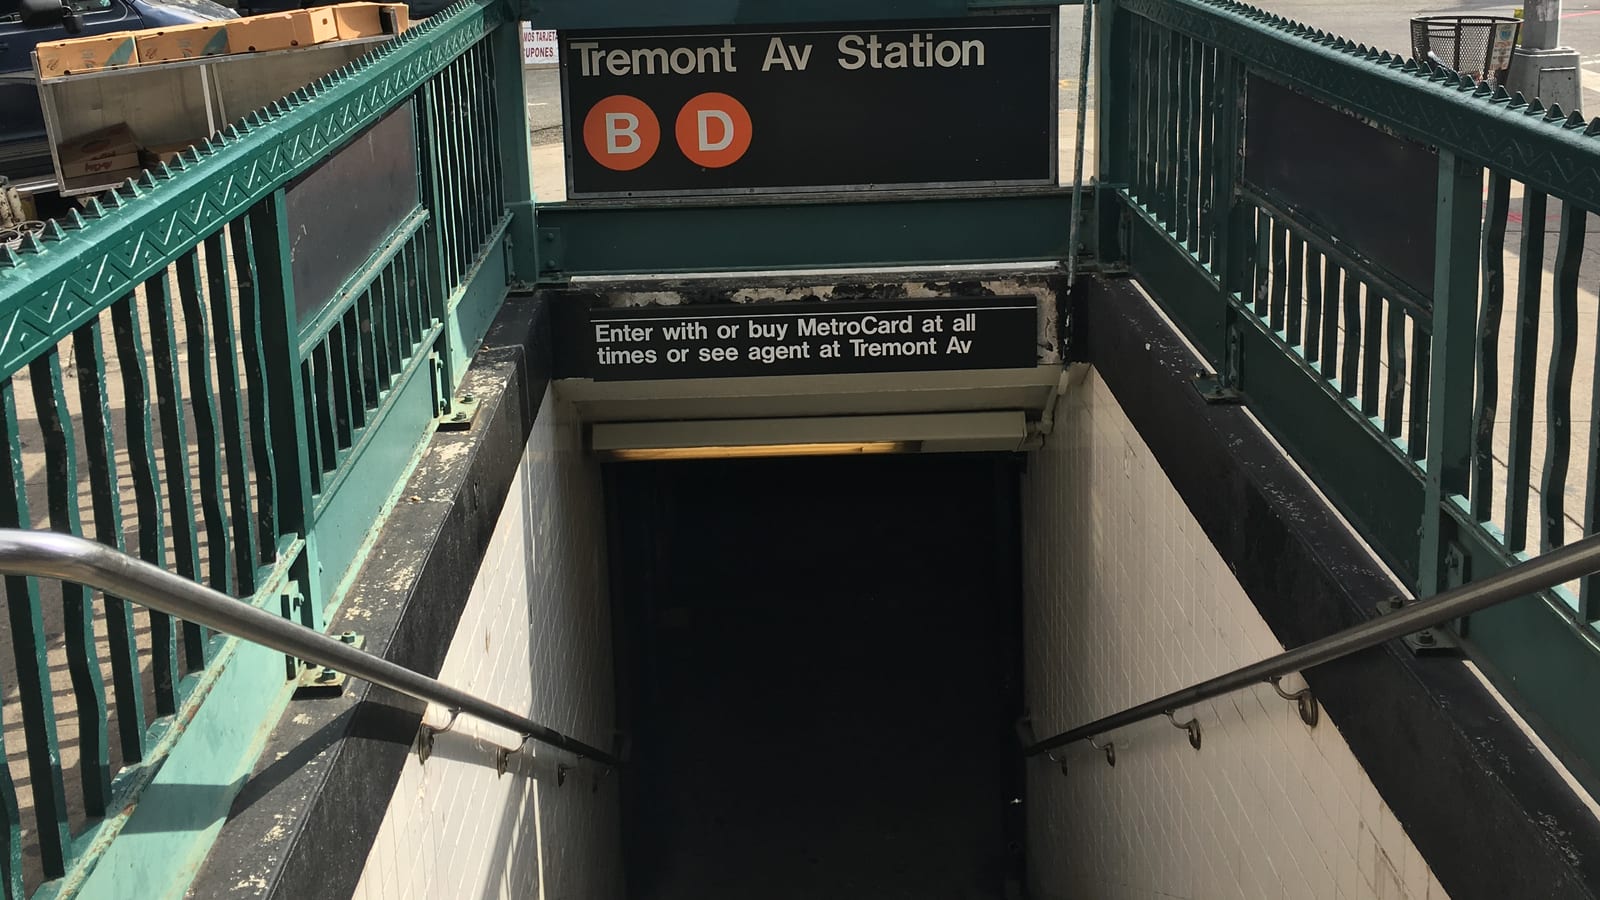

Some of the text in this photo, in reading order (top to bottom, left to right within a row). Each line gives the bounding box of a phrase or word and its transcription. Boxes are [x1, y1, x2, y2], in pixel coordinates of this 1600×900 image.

[536, 31, 557, 42] TARJET
[524, 47, 554, 58] UPONES
[570, 36, 985, 77] Tremont Av Station
[606, 109, 734, 154] B D
[595, 313, 976, 343] Enter with or buy MetroCard at all
[597, 336, 973, 365] times or see agent at Tremont Av
